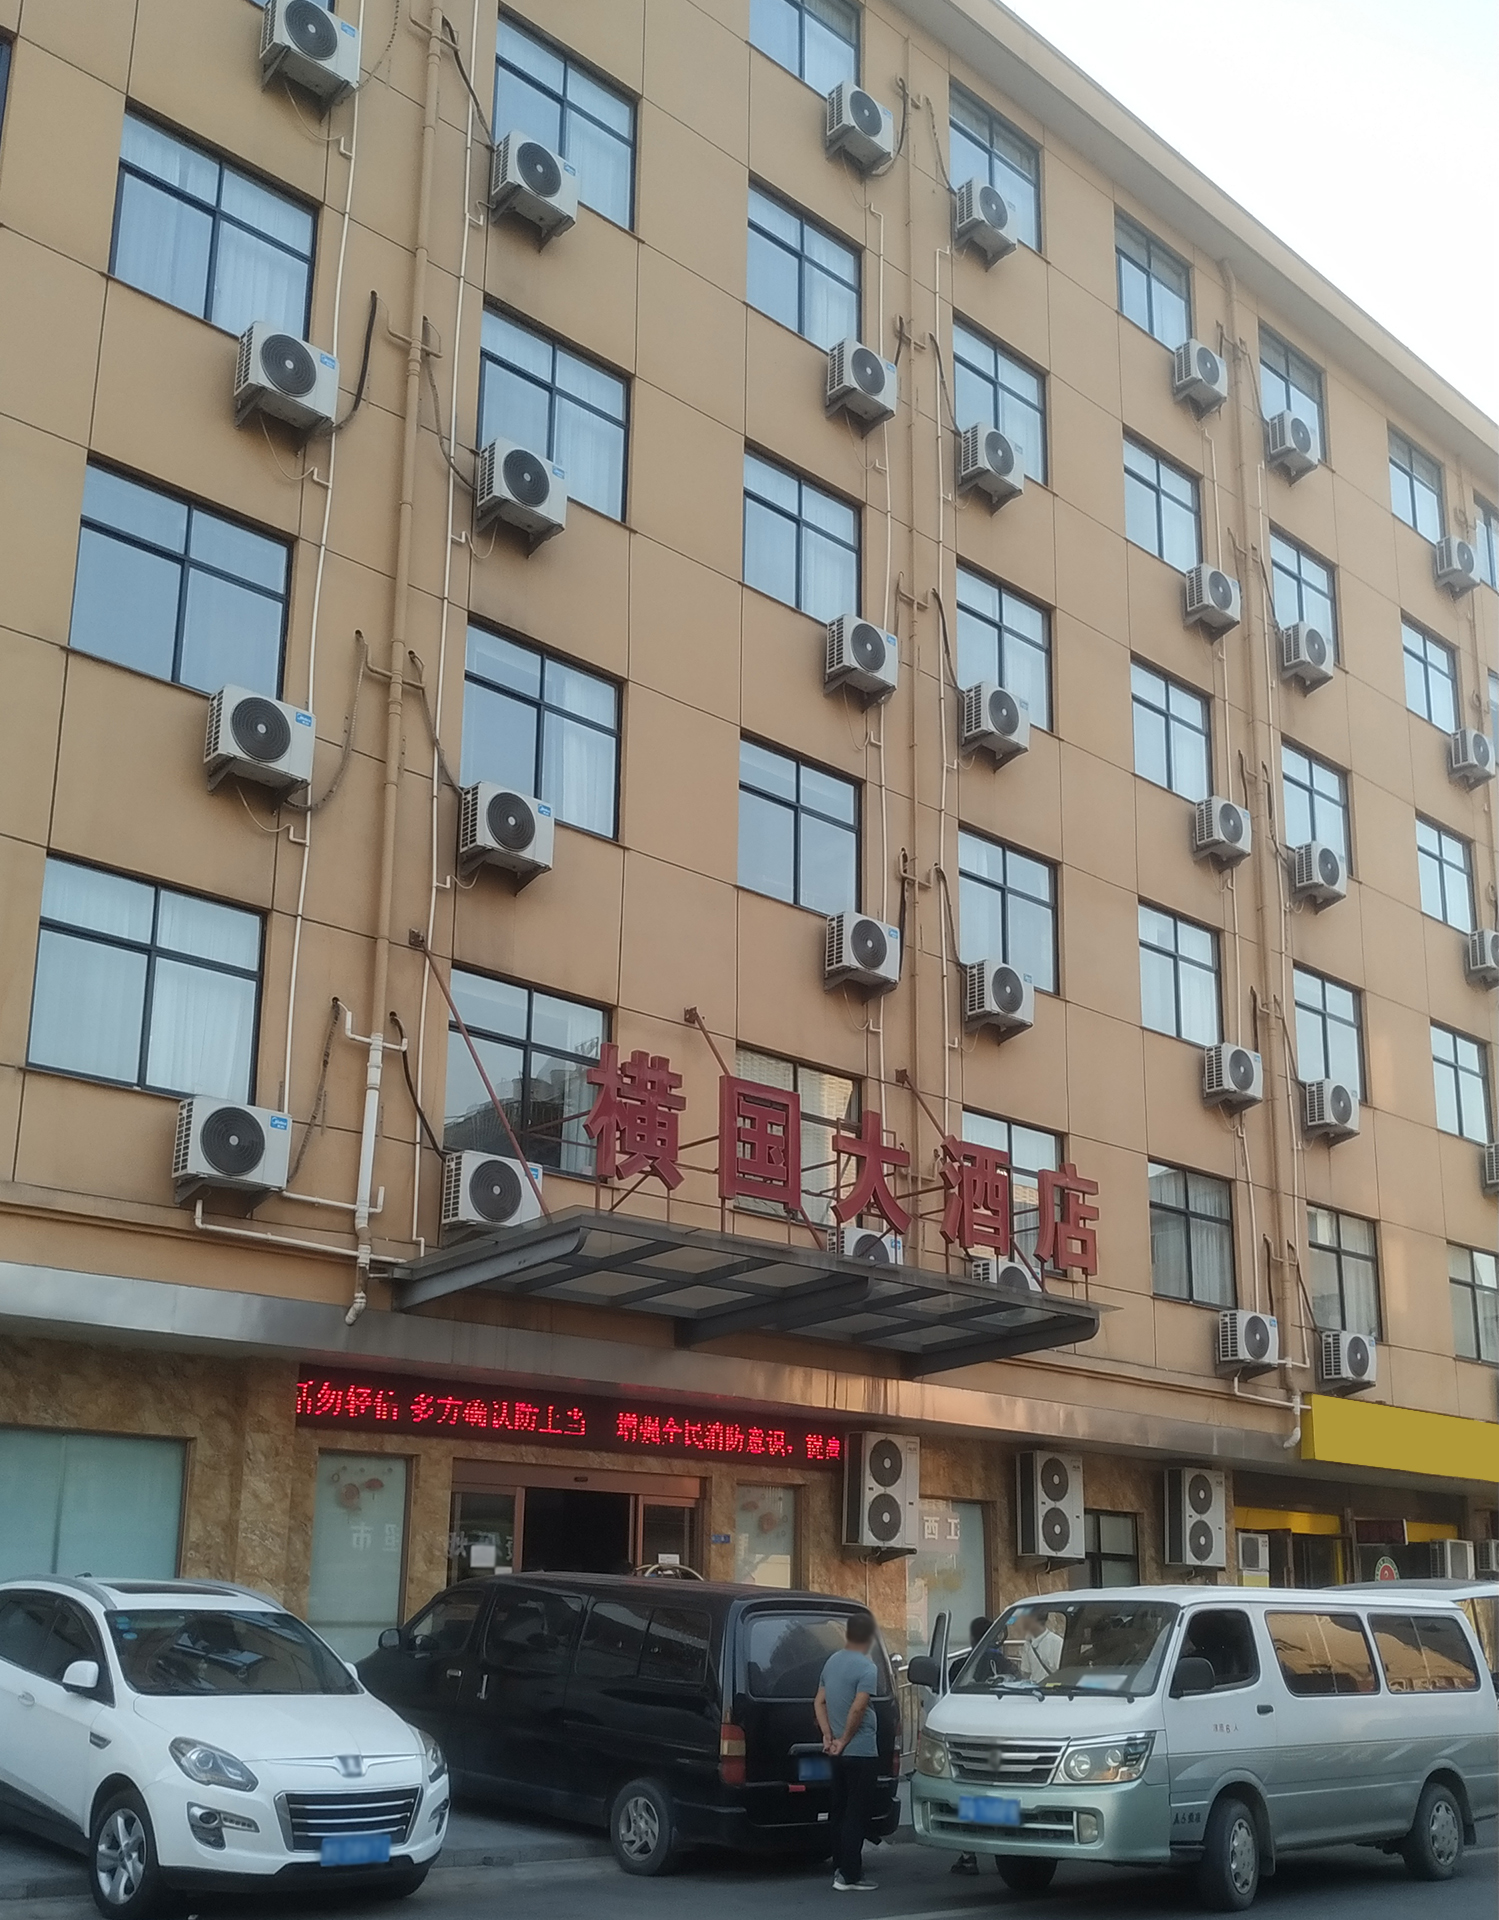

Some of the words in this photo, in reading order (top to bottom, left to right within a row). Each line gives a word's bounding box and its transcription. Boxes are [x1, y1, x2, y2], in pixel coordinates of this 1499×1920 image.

[583, 1042, 1099, 1277] 横国大酒店
